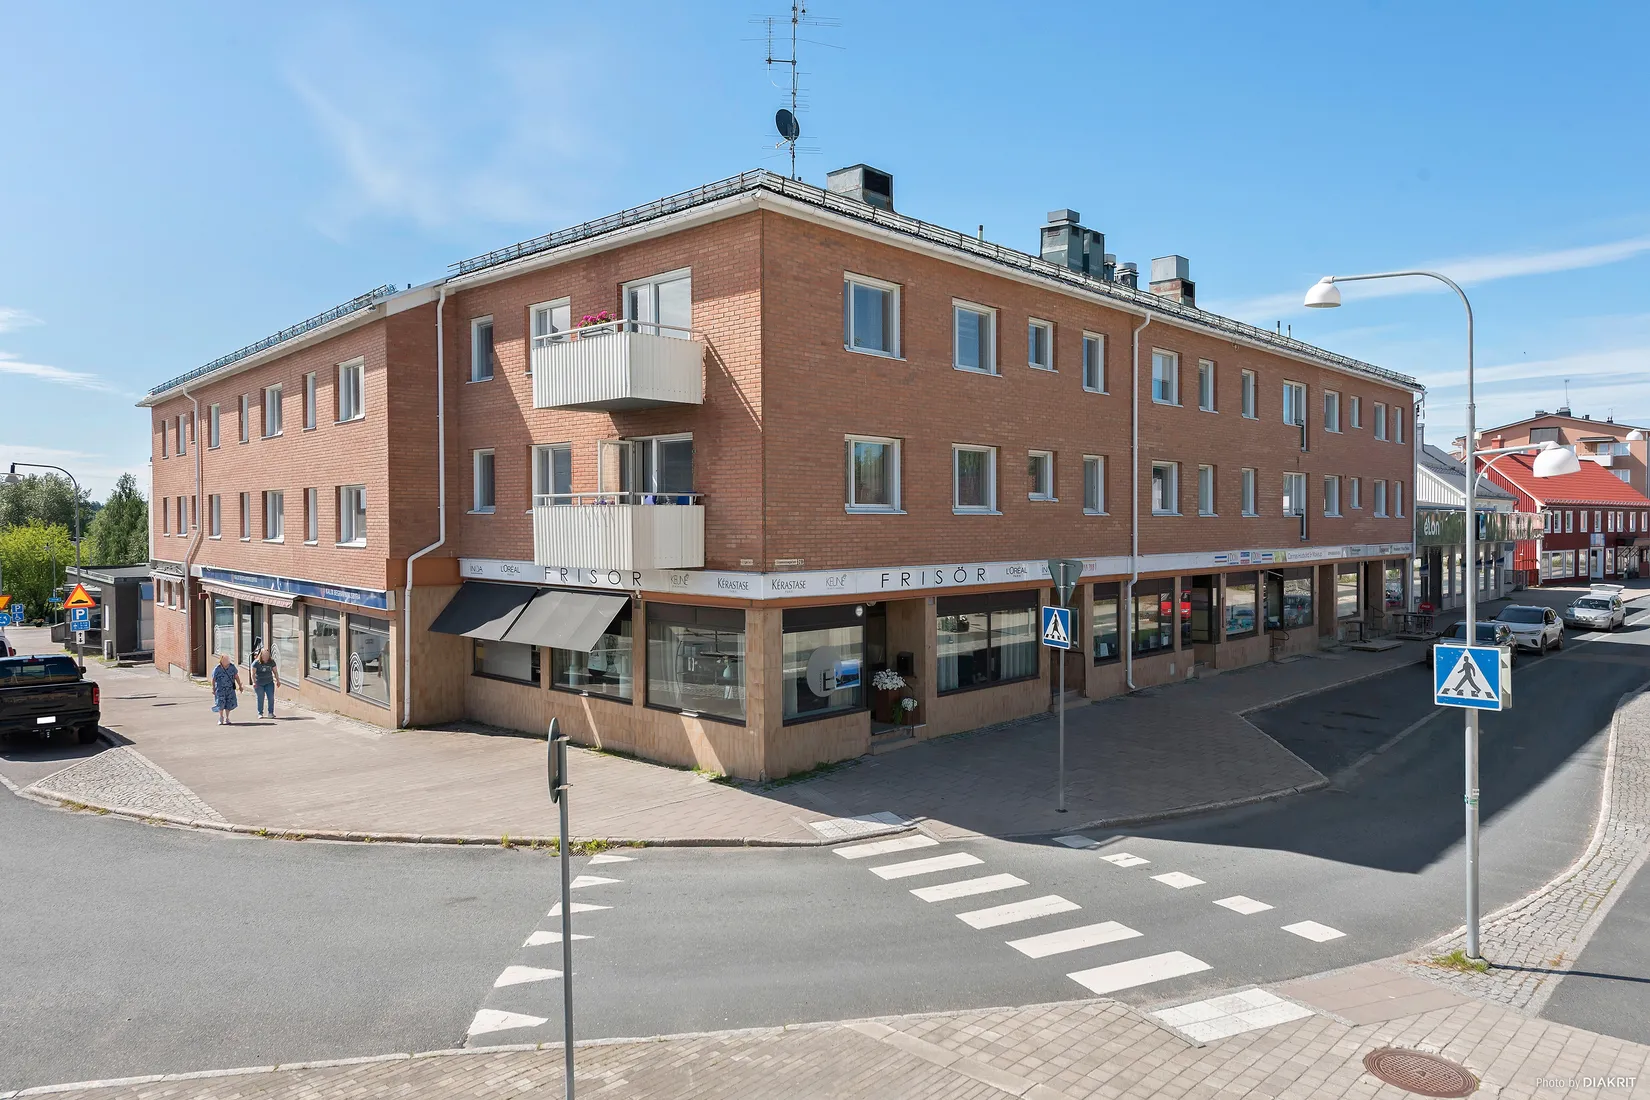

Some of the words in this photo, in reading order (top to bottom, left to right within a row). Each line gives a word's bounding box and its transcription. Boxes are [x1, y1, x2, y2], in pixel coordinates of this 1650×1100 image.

[544, 566, 642, 586] FRISÖR
[881, 566, 986, 588] FRISÖR
[717, 577, 749, 591] KÉRASTASE
[771, 578, 806, 590] KÉRASTASE
[76, 610, 85, 620] P
